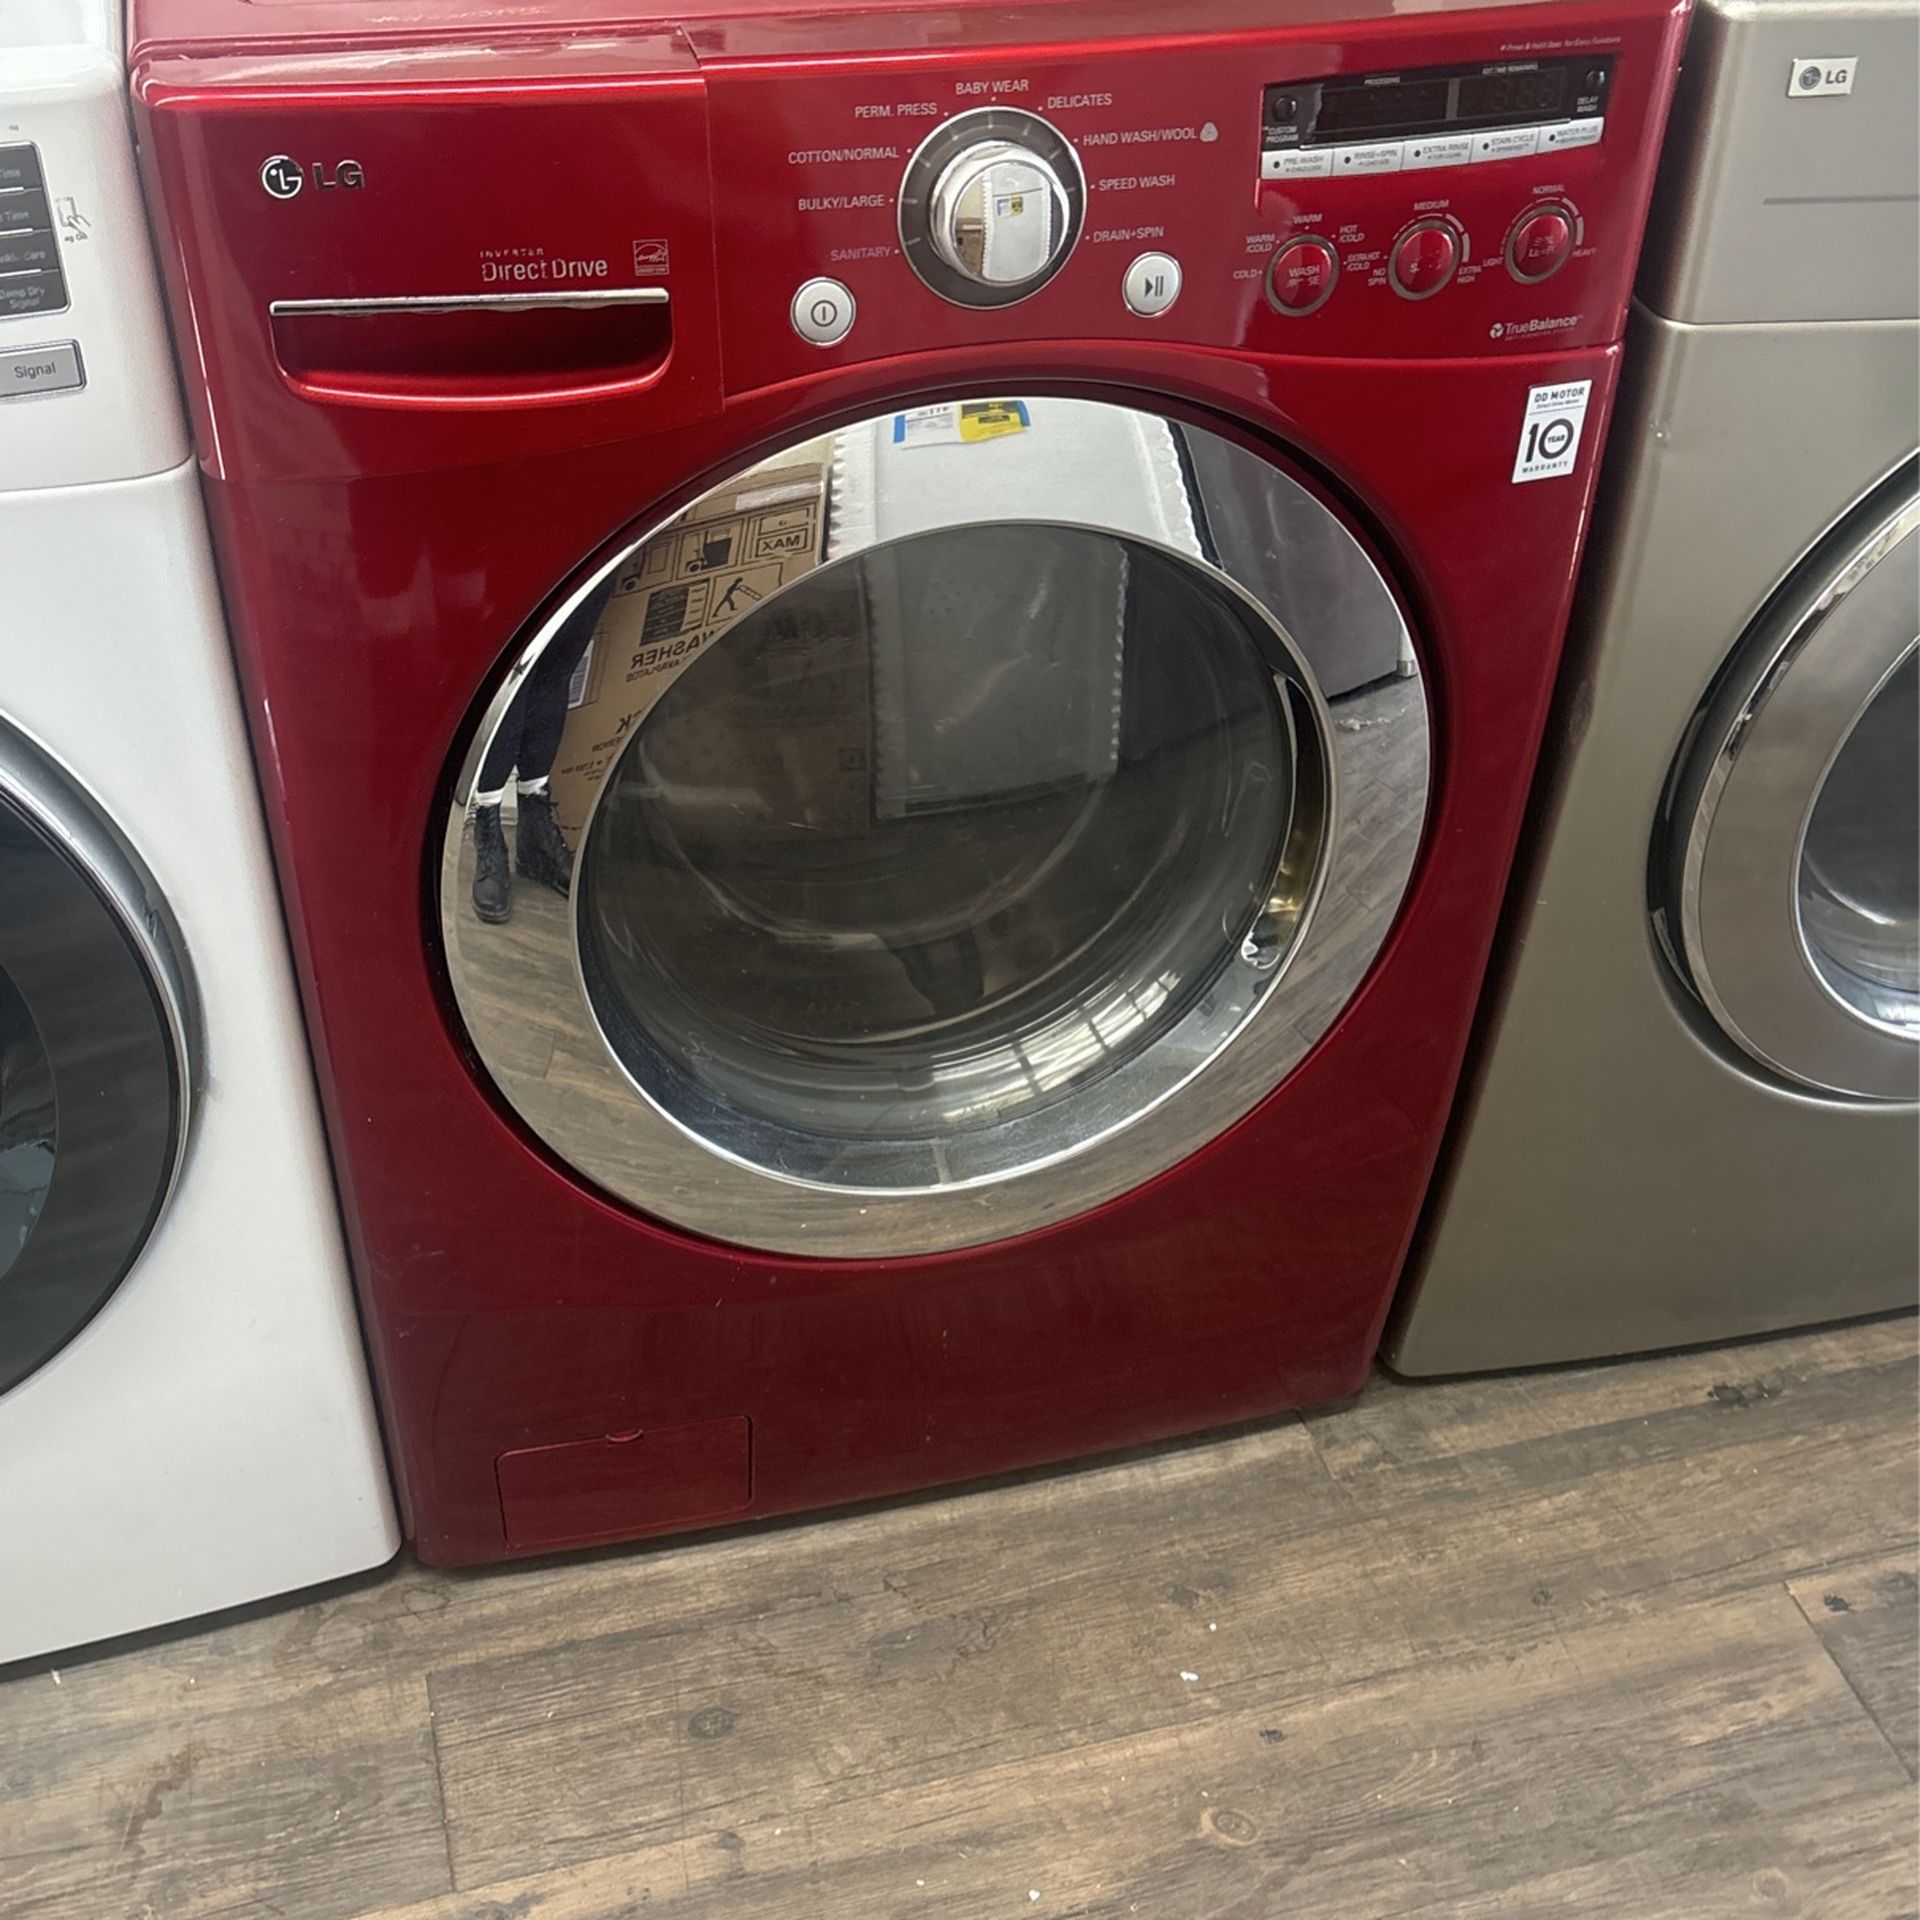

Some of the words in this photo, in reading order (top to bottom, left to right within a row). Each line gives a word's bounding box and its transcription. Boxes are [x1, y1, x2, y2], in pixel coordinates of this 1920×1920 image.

[1825, 69, 1848, 84] LG
[955, 82, 989, 95] BABY
[992, 79, 1029, 92] WEAR
[1048, 93, 1112, 109] DELICATES
[855, 105, 894, 118] PERM.
[897, 103, 937, 116] PRESS
[1083, 132, 1118, 146] HAND
[1120, 128, 1197, 144] WASH/WOOL
[1513, 134, 1535, 143] CYCLE
[1423, 145, 1446, 154] EXTRA
[1448, 142, 1469, 151] RINSE
[788, 147, 900, 165] COTTON/NORMAL
[312, 159, 366, 191] LG
[1099, 177, 1137, 191] SPEED
[1139, 175, 1175, 188] WASH
[1533, 184, 1565, 194] NORMAL
[798, 194, 885, 211] BULKY/LARGE
[1414, 200, 1449, 211] MEDIUM
[1293, 213, 1323, 224] WARM
[1093, 227, 1164, 242] DRAIN+SPIN
[1339, 225, 1358, 234] HOT
[1246, 234, 1275, 244] WARM
[831, 246, 892, 261] SANITARY
[482, 260, 548, 282] Direct
[552, 258, 608, 278] Drive
[1233, 270, 1257, 279] COLD
[1289, 265, 1320, 277] WASH
[1373, 268, 1385, 276] NO
[1458, 265, 1482, 275] EXTRA
[14, 362, 56, 380] Signal
[1534, 393, 1548, 403] DD
[1551, 387, 1585, 400] MOTOR
[1525, 418, 1574, 463] 10
[1547, 434, 1565, 443] YEAR
[1522, 461, 1568, 473] WARRANTY
